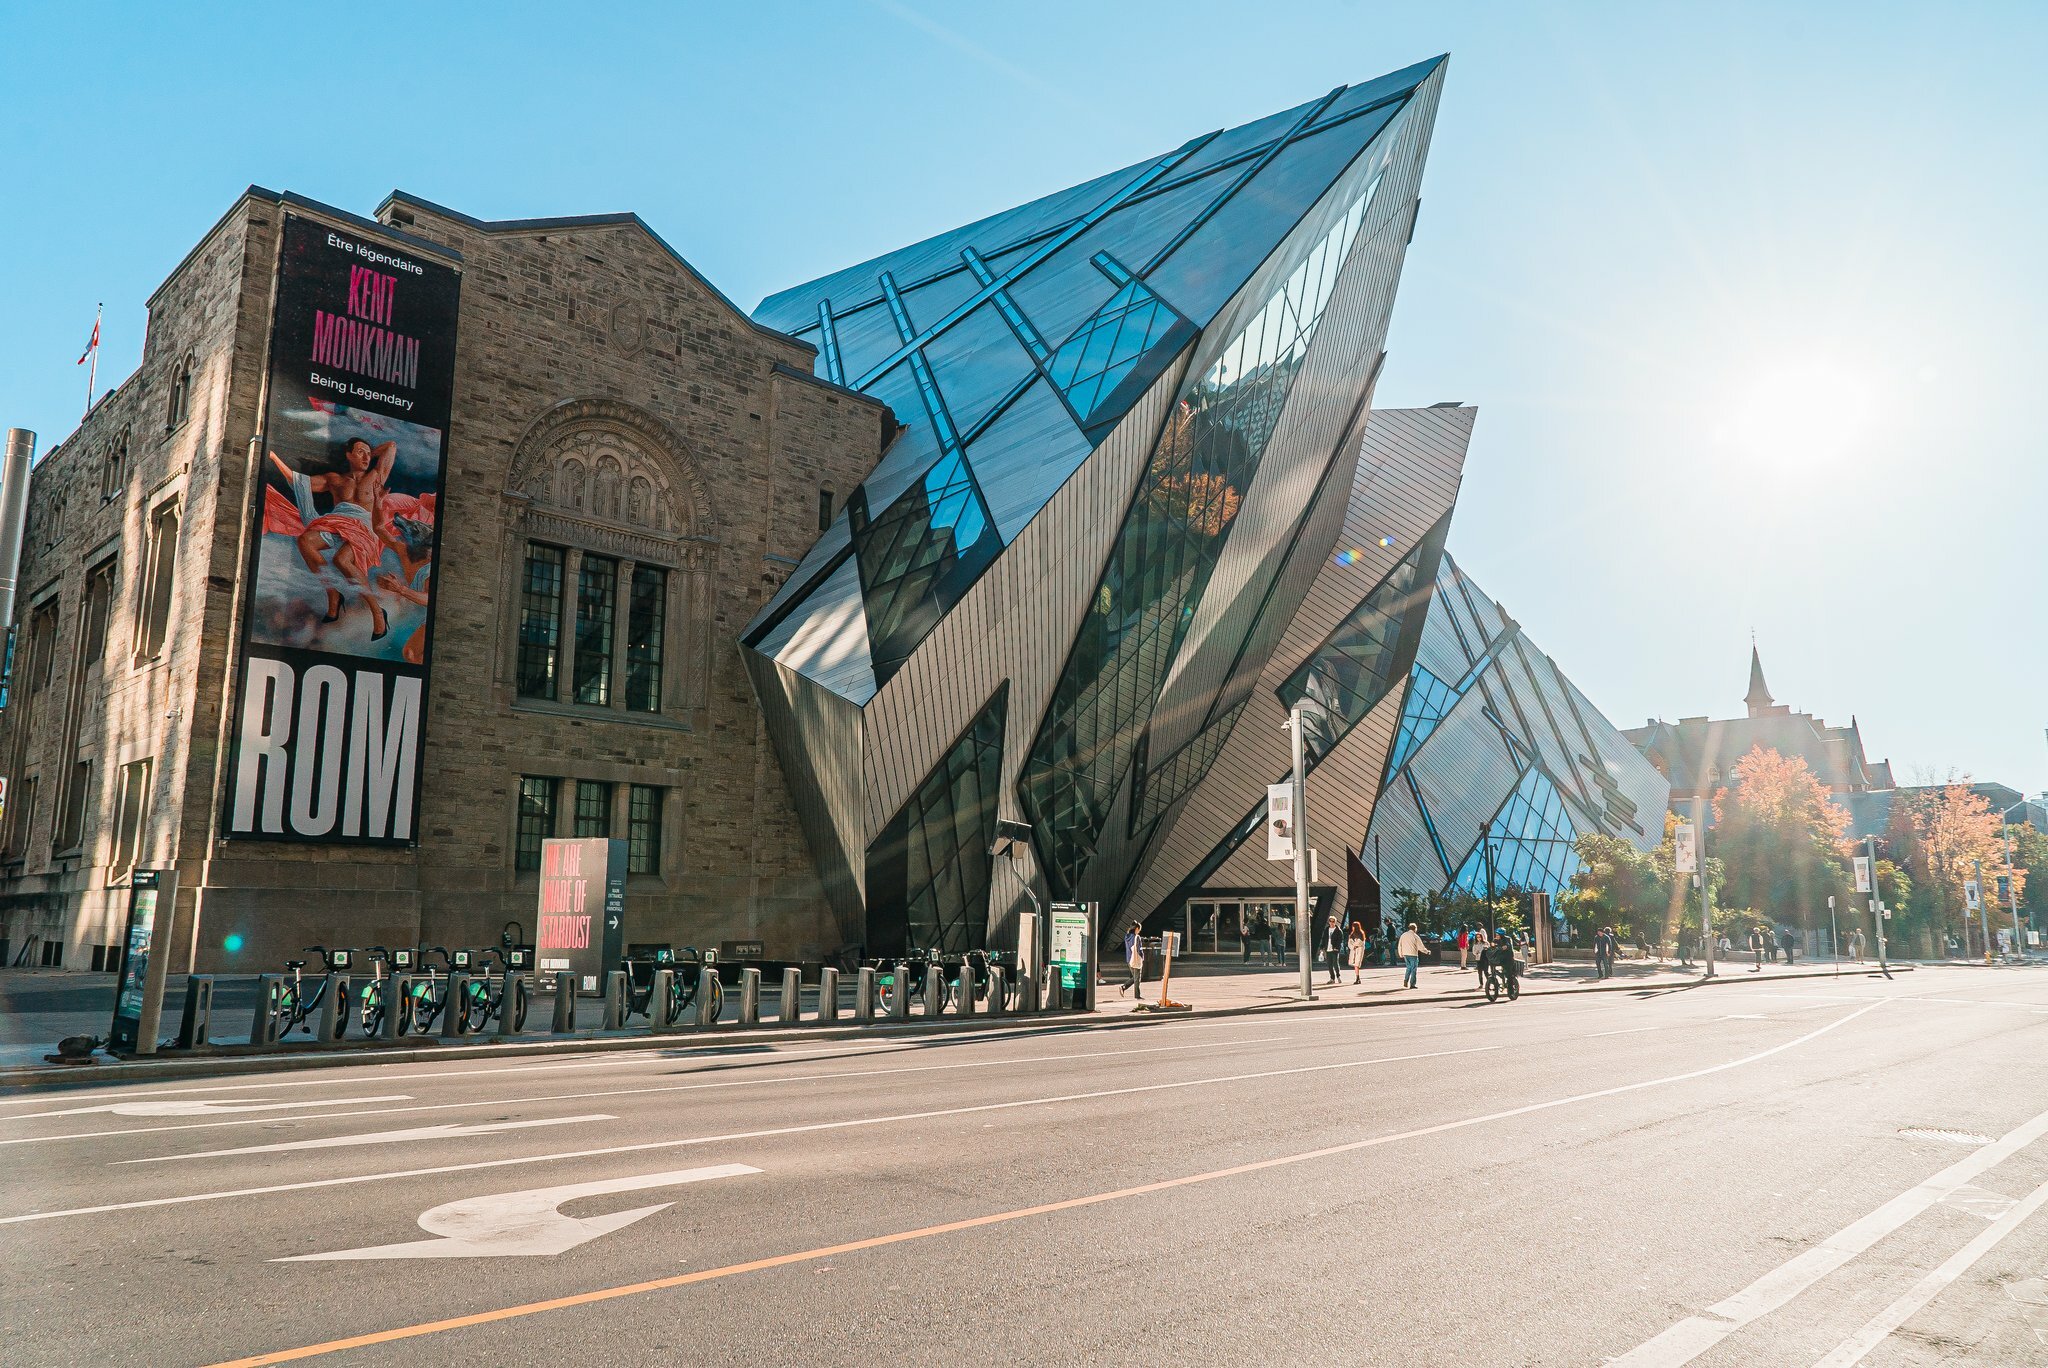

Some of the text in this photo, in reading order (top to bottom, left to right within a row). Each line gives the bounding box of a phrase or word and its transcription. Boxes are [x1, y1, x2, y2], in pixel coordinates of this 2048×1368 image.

[327, 232, 423, 276] Être légendaire
[347, 264, 398, 326] KENT
[311, 309, 420, 389] MONKMAN
[310, 372, 414, 411] Being Legendary
[232, 657, 422, 839] ROM
[545, 844, 582, 877] WE ARE
[543, 880, 588, 913] MADE OF
[541, 916, 592, 949] STARDUST
[583, 975, 597, 990] ROM
